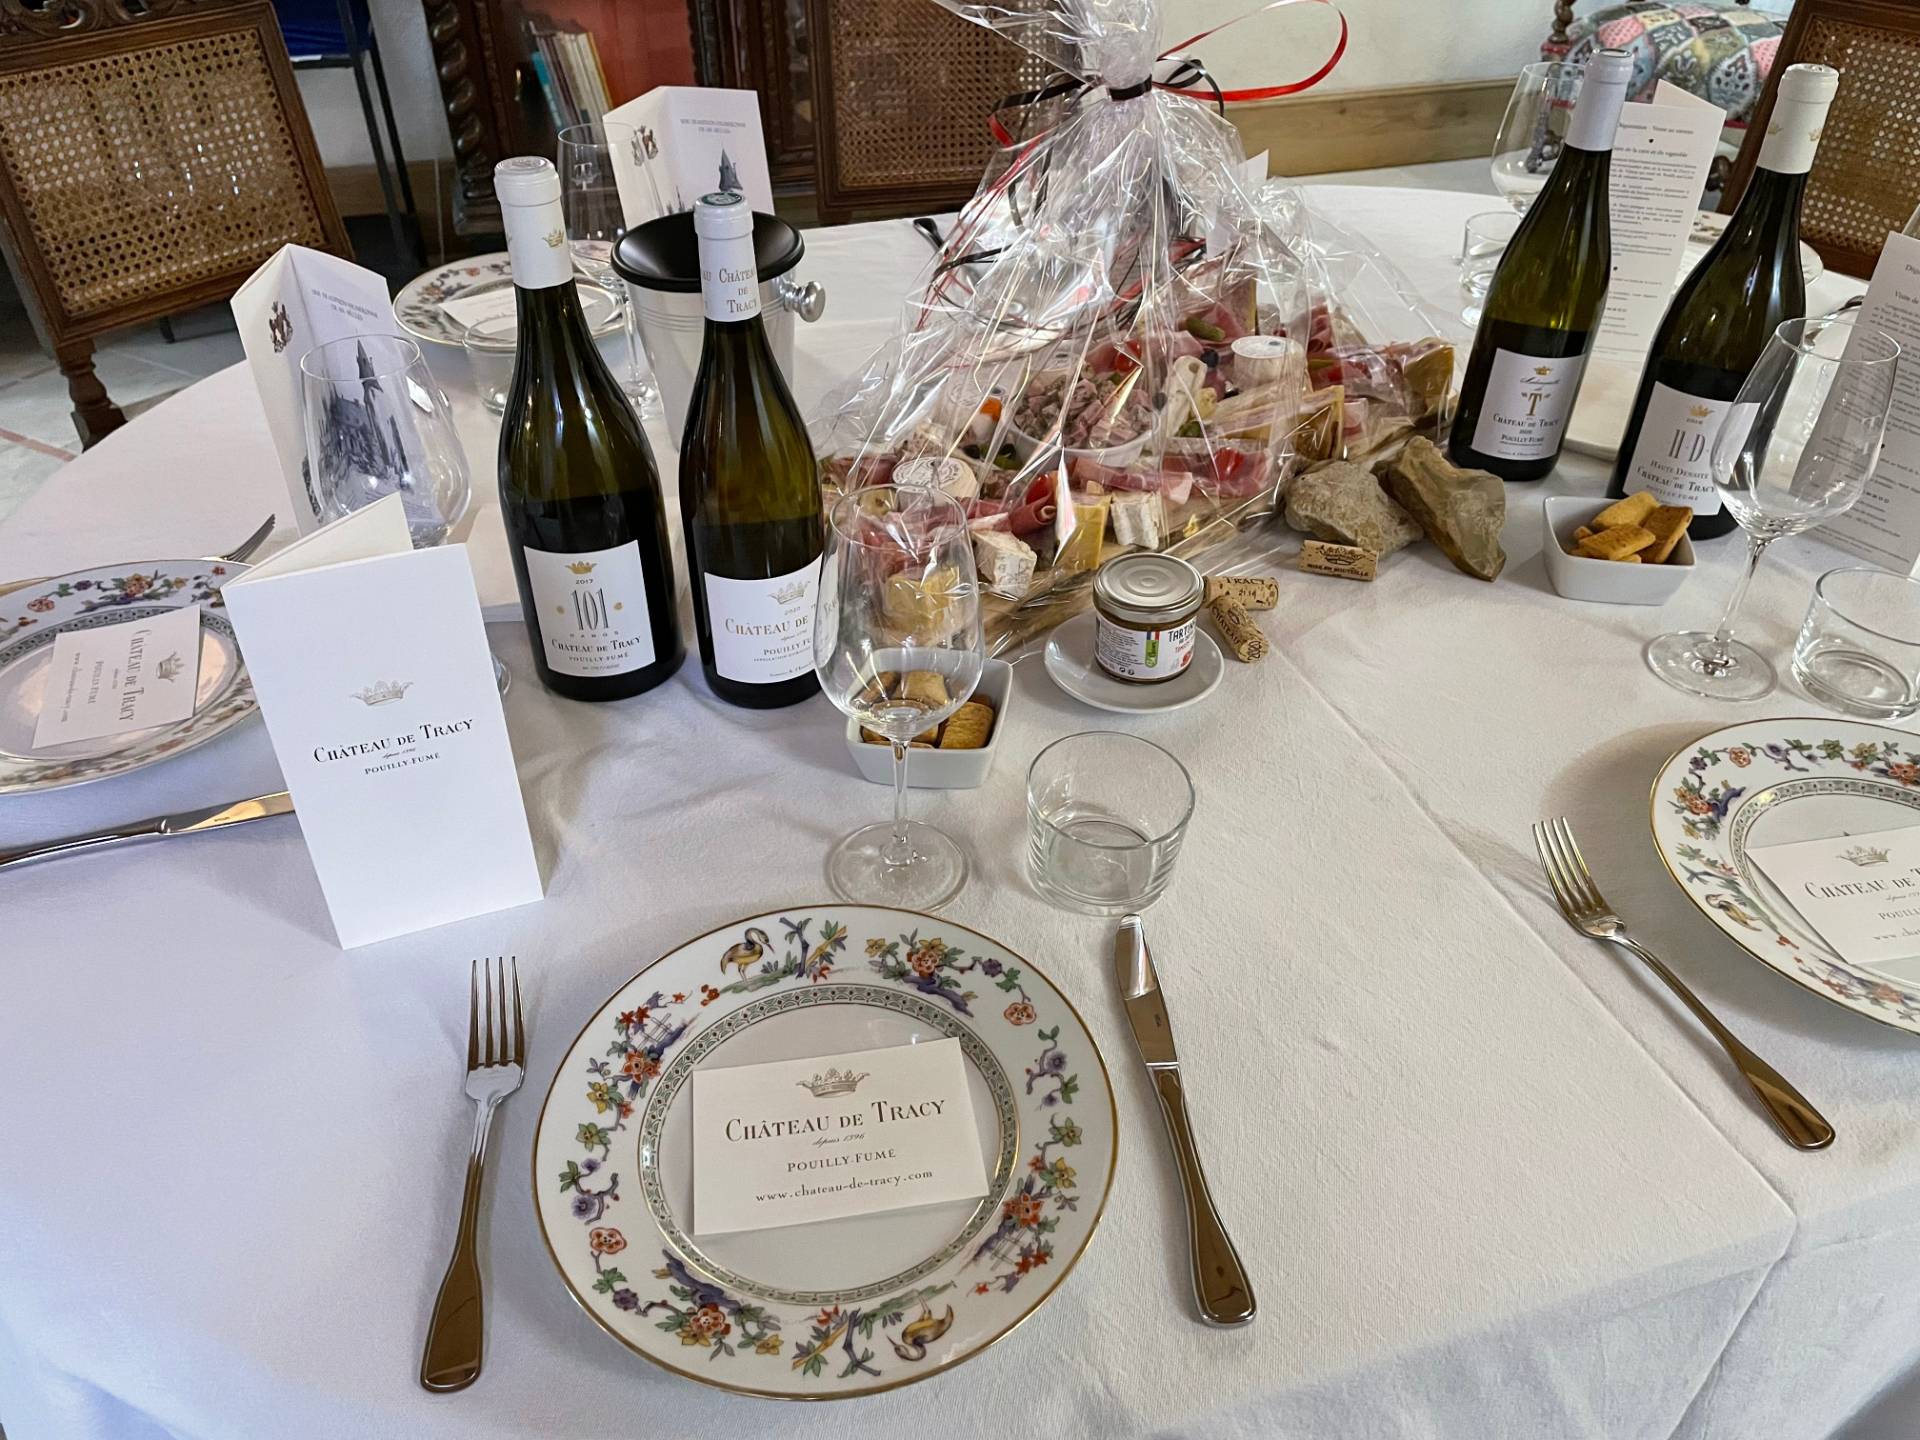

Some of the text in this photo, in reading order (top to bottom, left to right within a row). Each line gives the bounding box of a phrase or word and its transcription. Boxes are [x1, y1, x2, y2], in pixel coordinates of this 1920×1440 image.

[738, 287, 750, 295] DE
[571, 587, 609, 631] 101
[795, 615, 809, 629] DE
[596, 645, 608, 653] DE
[610, 636, 642, 650] TRACY
[124, 675, 137, 688] DE
[119, 687, 145, 721] TRACY
[313, 718, 474, 763] CHÂTEAU DE TRACY
[1891, 877, 1915, 889] DE
[725, 1099, 945, 1142] CHÂTEAU DE TRACY
[755, 1169, 934, 1202] www.chateau-de-tracy.com
